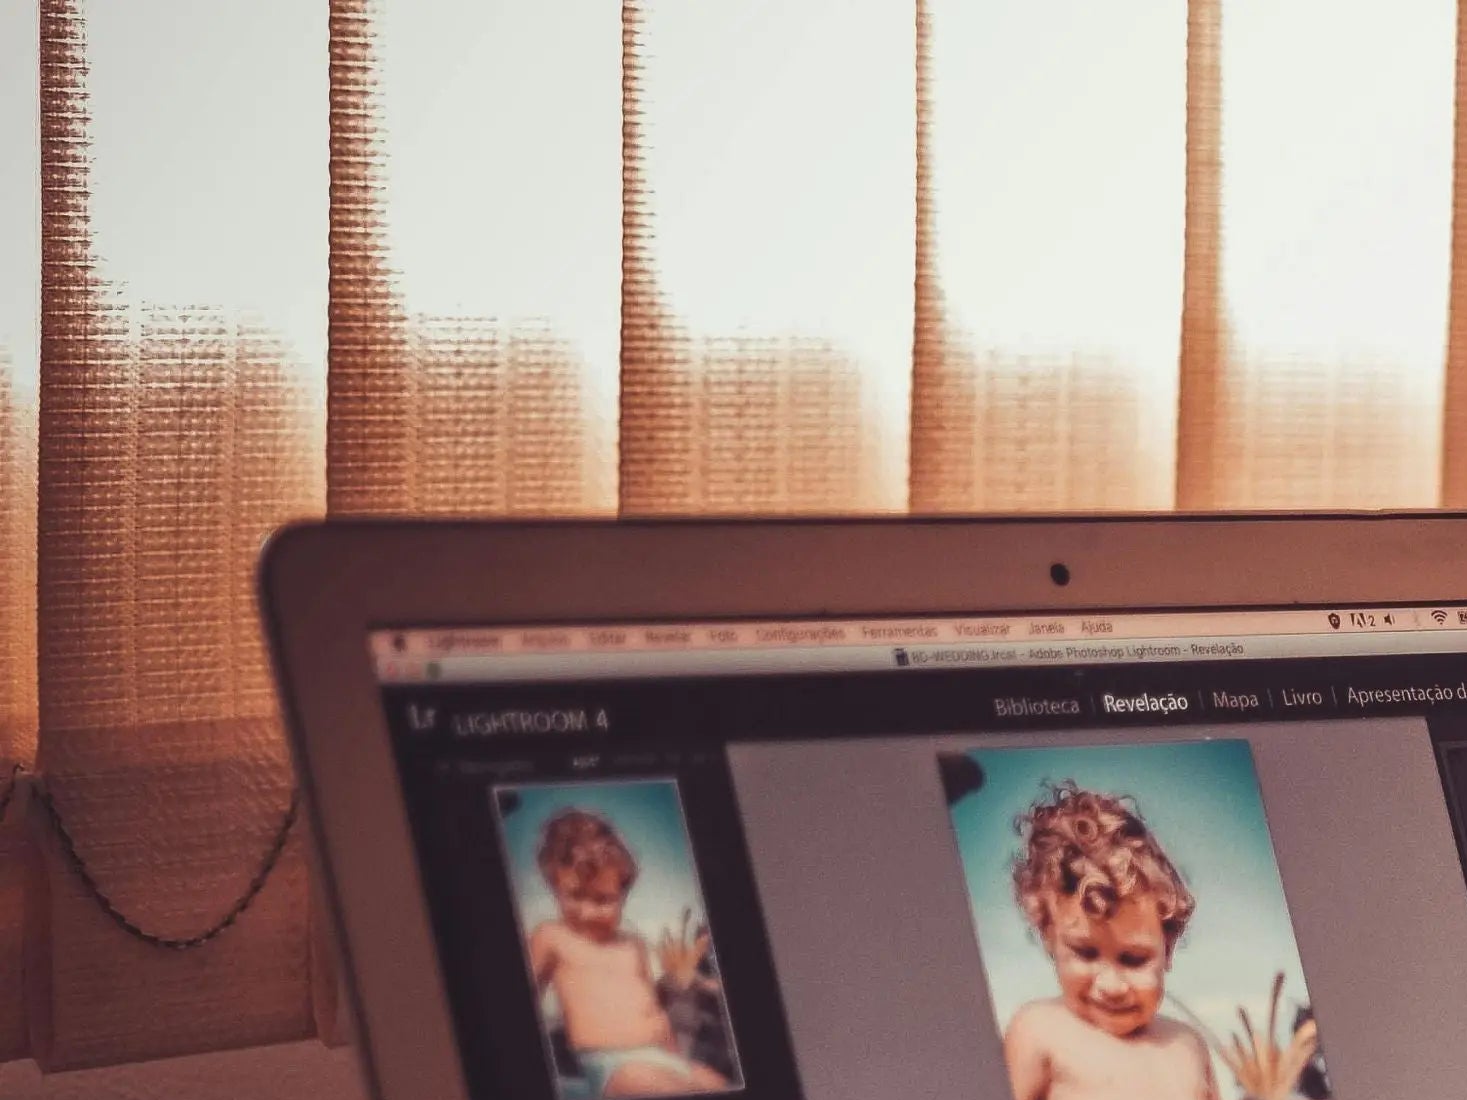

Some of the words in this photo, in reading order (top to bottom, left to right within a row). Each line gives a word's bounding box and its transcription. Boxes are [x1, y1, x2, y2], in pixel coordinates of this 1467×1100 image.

[862, 624, 940, 640] Ferramentas
[1081, 619, 1115, 634] Ajuda
[1028, 646, 1064, 660] Adobe
[1066, 645, 1124, 660] Photoshop
[1127, 644, 1181, 658] Lightroom
[1191, 642, 1245, 657] Revelação
[995, 698, 1081, 717] Biblioteca
[1104, 692, 1189, 715] Revelação
[1213, 691, 1260, 710] Mapa
[1282, 688, 1323, 707] Livro
[1347, 685, 1453, 706] Apresentação
[456, 708, 588, 736] LIGHTROOM
[596, 709, 611, 730] 4
